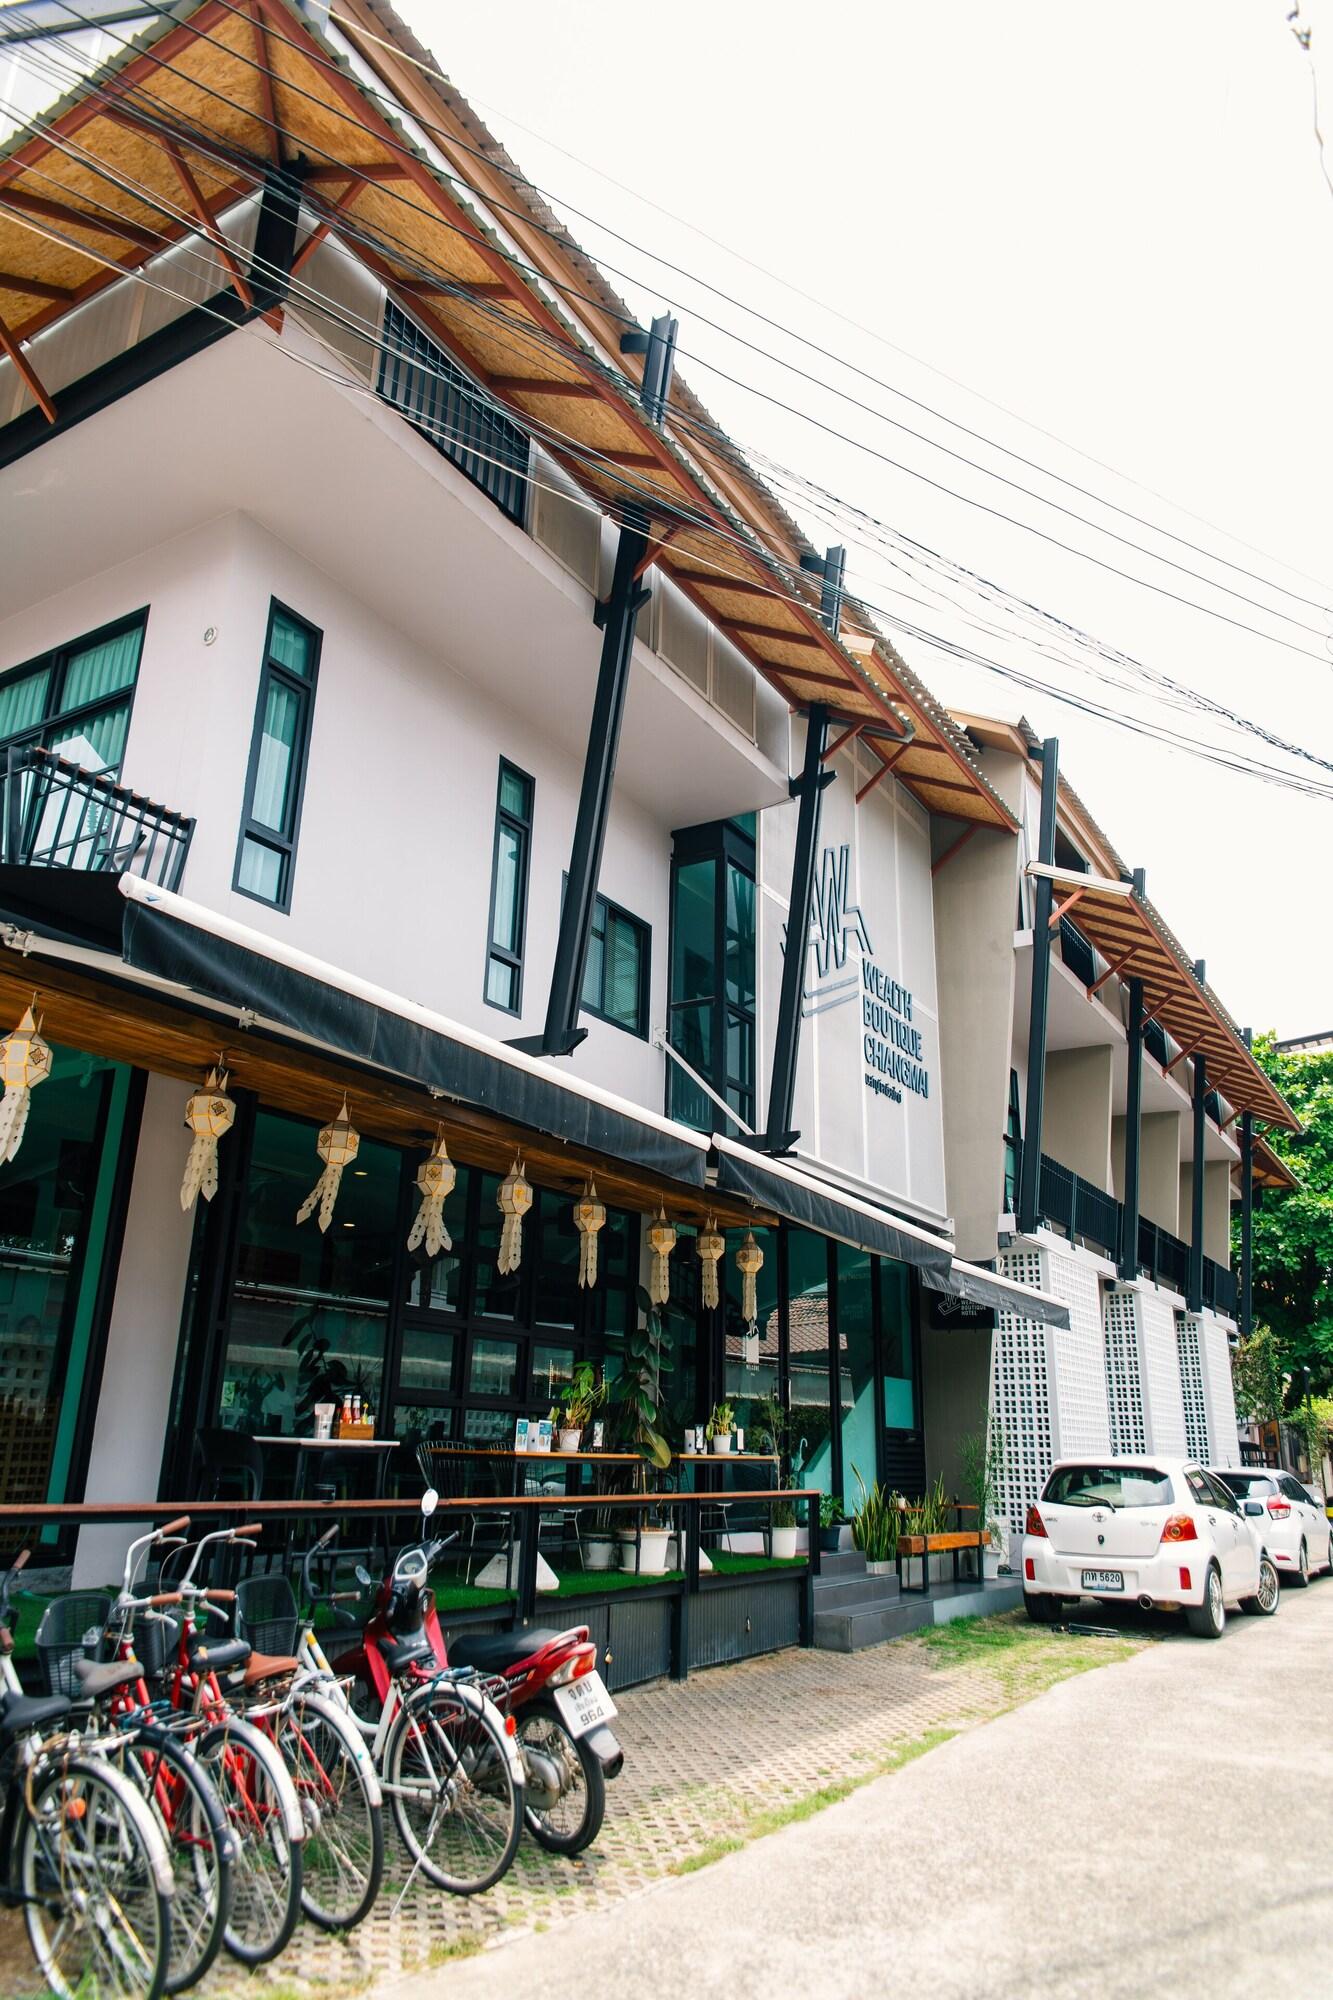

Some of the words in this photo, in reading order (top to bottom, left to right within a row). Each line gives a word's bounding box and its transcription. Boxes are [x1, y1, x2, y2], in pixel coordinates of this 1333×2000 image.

[862, 958, 912, 1021] WEALTH
[863, 995, 923, 1062] BOUTIQUE
[864, 1033, 928, 1098] CHIANGMAI
[1100, 1572, 1120, 1582] 5620
[580, 1706, 604, 1726] 964
